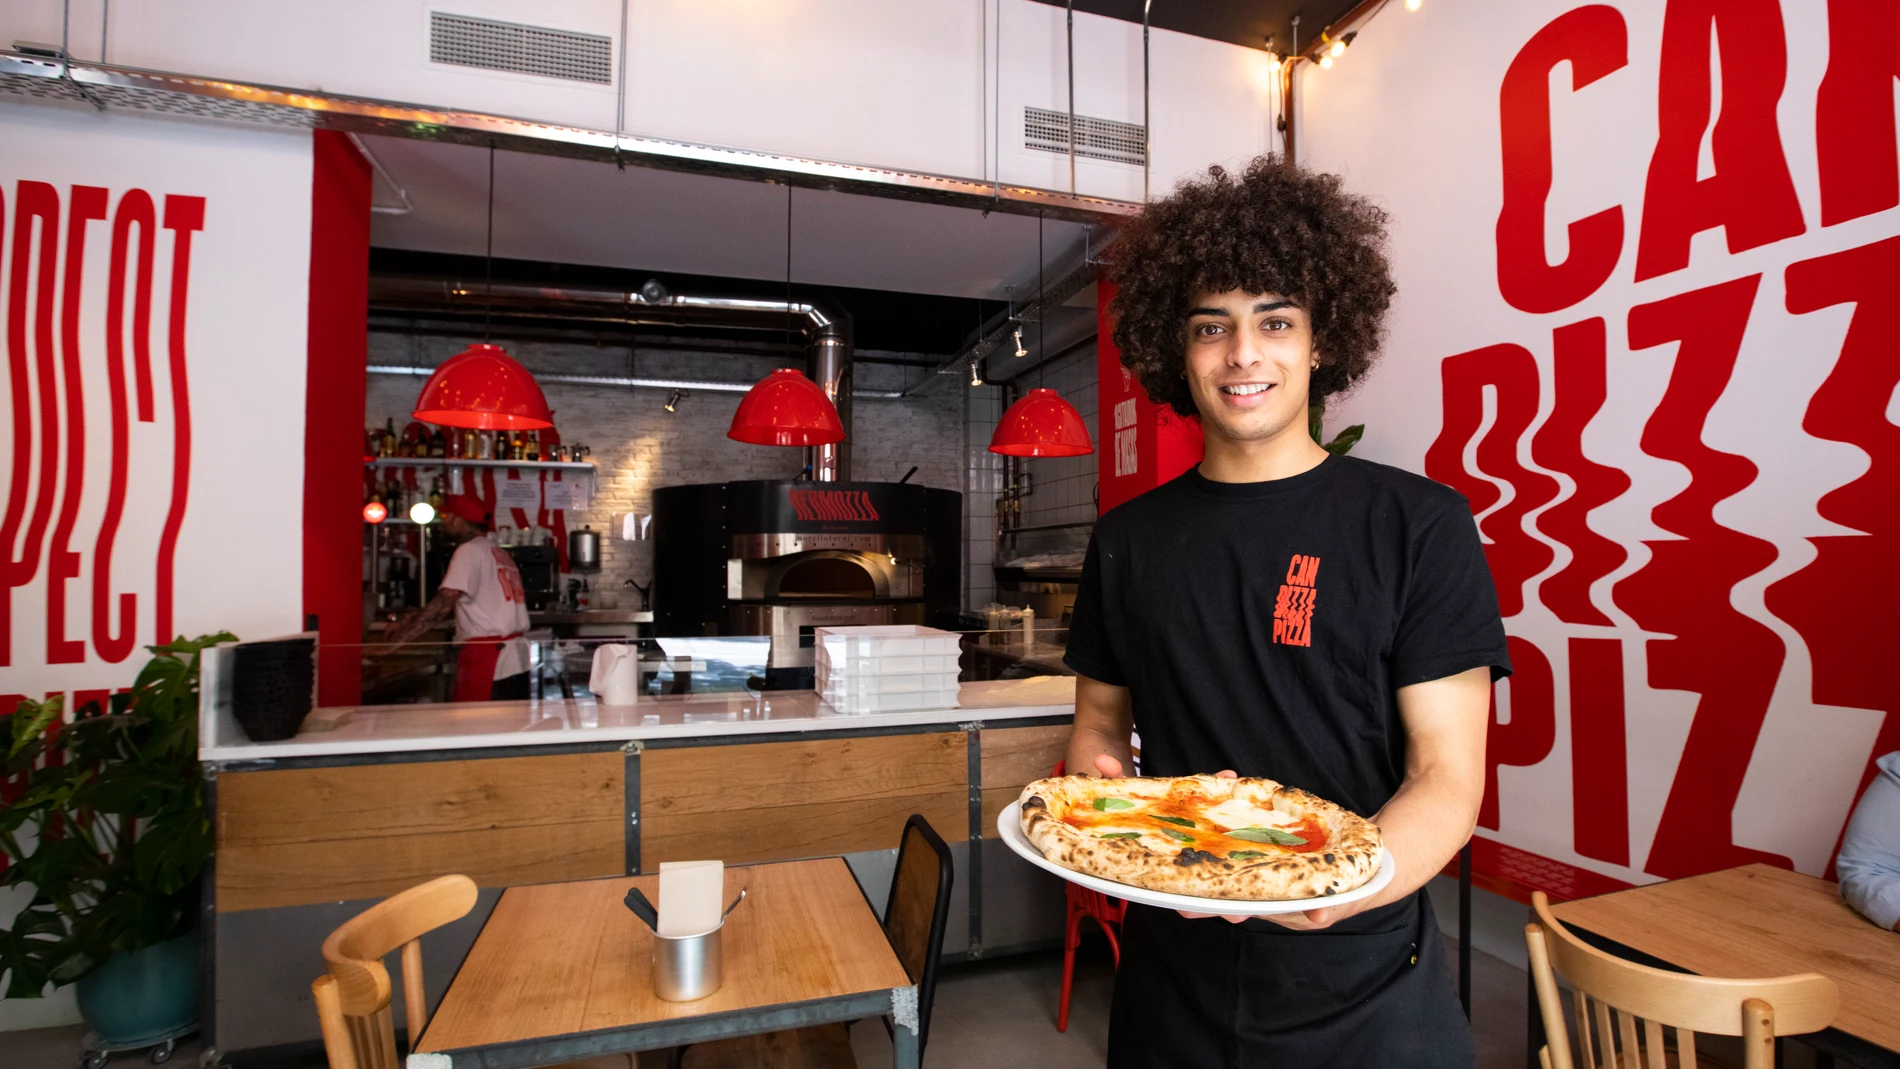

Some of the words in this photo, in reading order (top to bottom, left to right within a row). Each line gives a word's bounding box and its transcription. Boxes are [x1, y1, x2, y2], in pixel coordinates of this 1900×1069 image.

[0, 173, 206, 668] PECT
[1286, 554, 1321, 587] CAN
[1272, 618, 1312, 648] PIZZA
